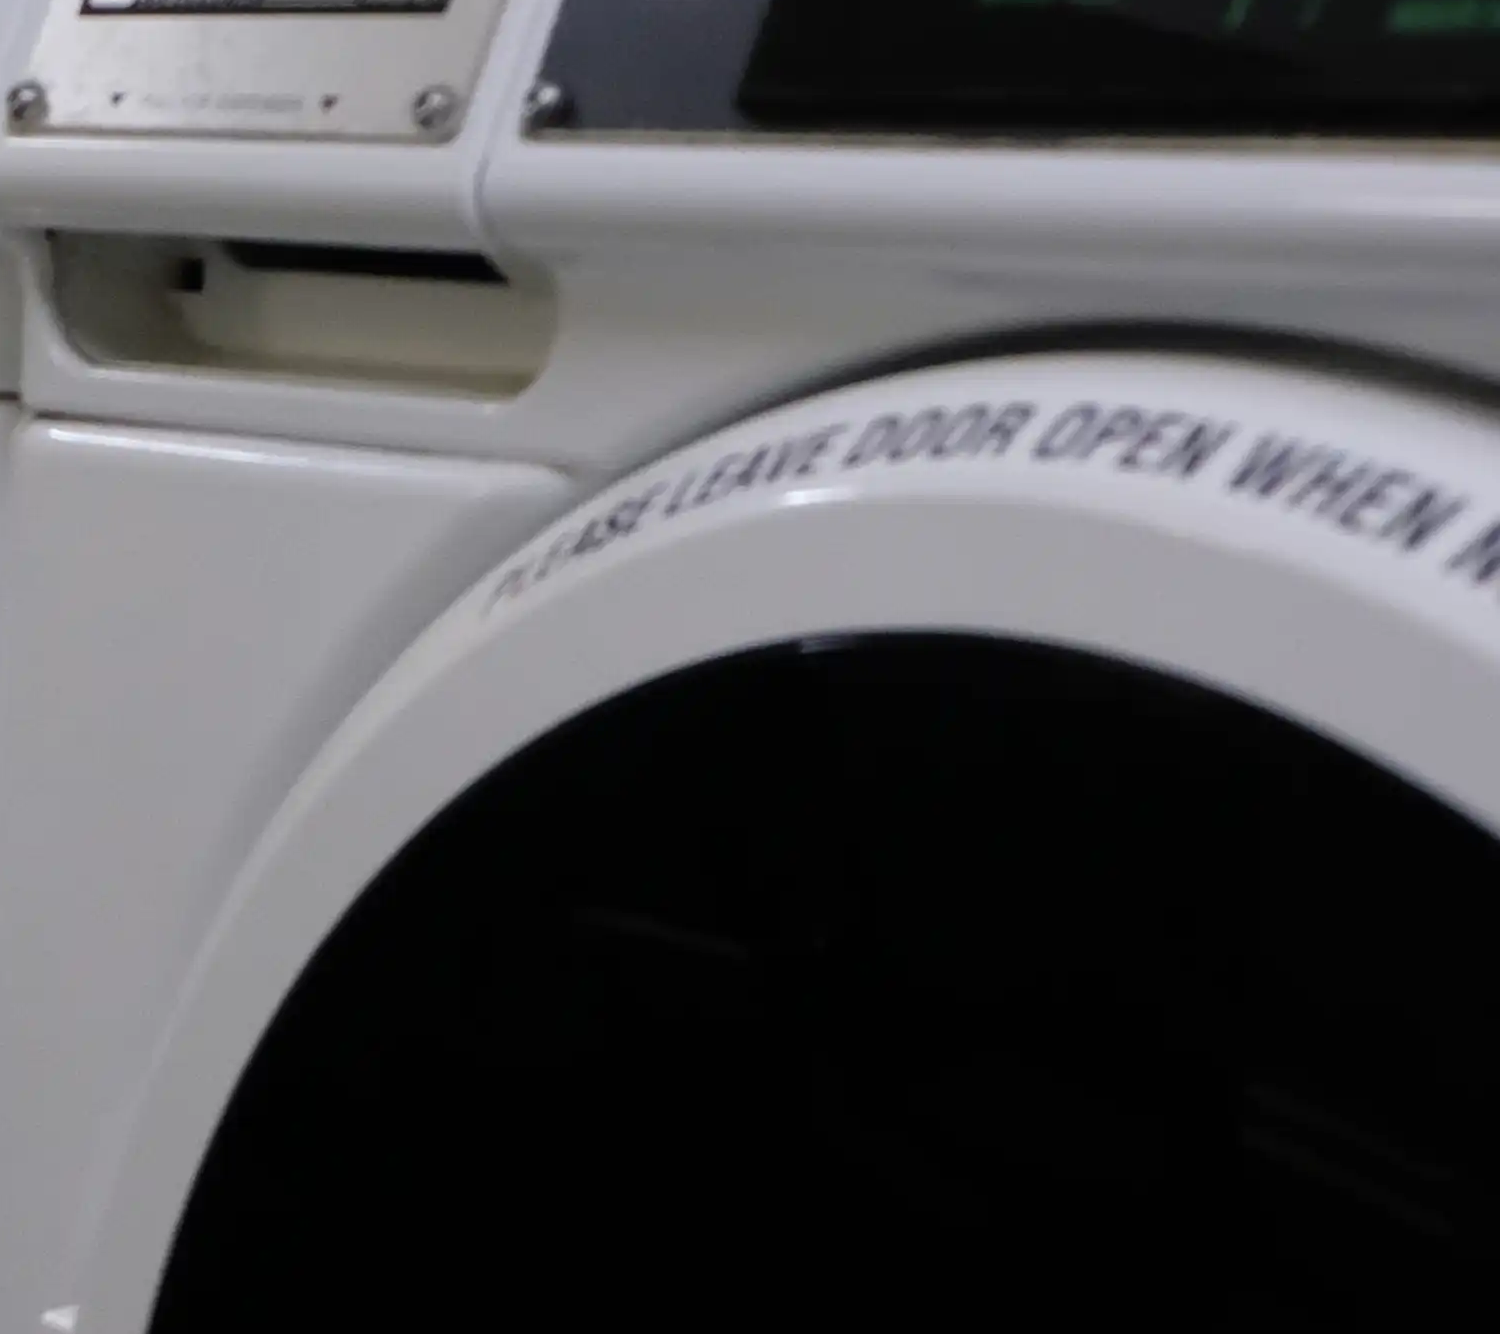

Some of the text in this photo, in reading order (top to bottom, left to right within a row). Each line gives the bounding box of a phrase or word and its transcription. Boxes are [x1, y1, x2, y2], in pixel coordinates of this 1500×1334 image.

[663, 420, 849, 518] LEAVE
[840, 401, 1038, 469] DOOR
[1030, 400, 1240, 481] OPEN
[1226, 427, 1472, 551] WHEN
